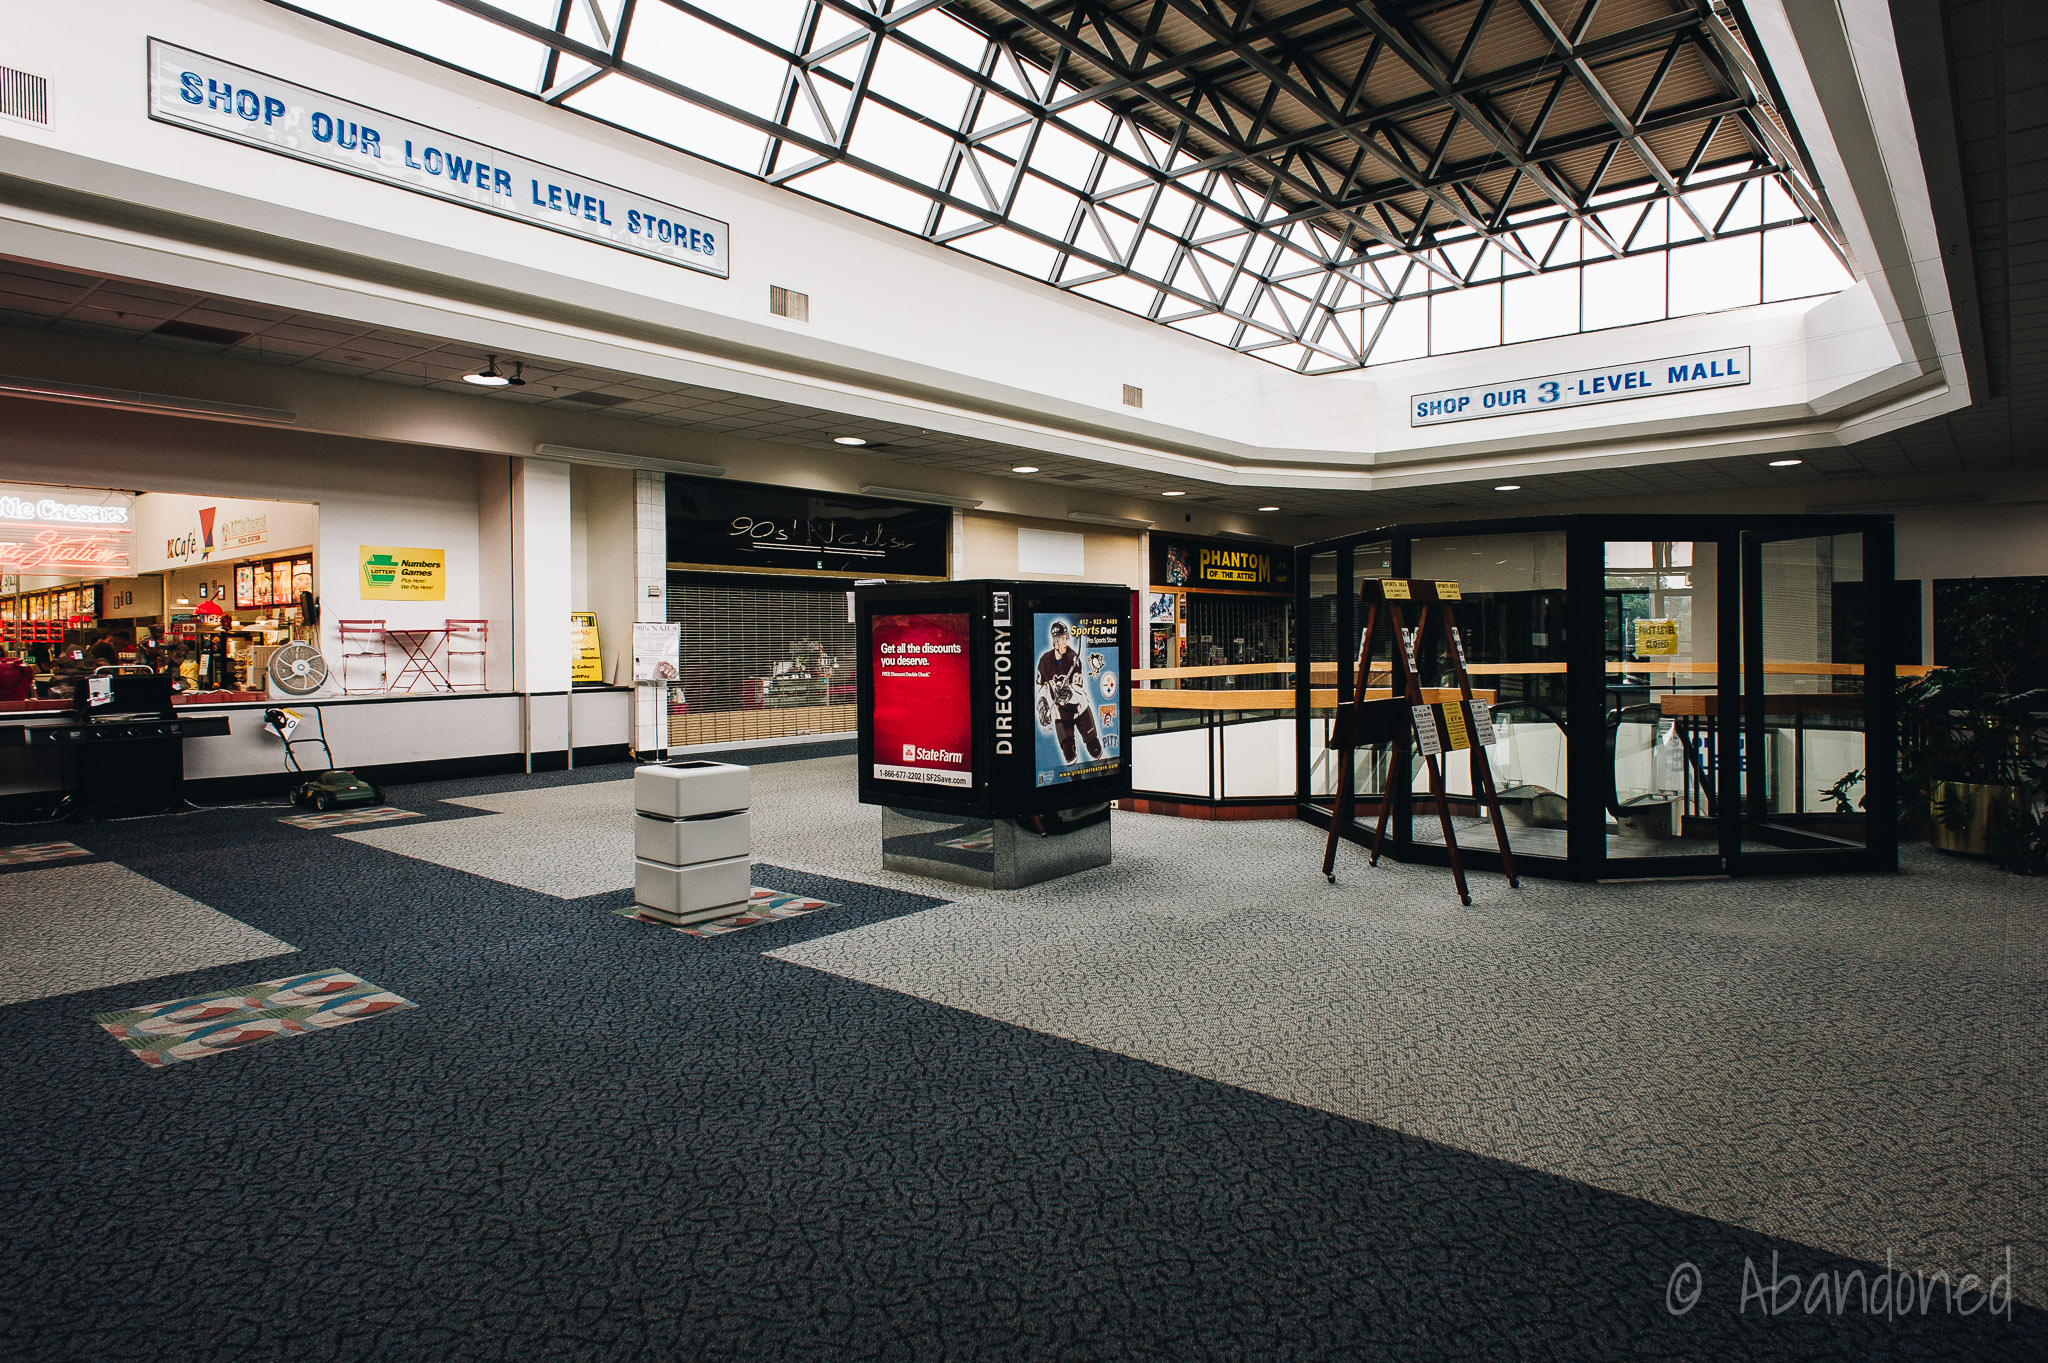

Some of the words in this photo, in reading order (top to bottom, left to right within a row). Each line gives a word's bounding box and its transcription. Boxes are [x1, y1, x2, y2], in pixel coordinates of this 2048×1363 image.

[179, 71, 286, 126] SHOP
[311, 111, 381, 158] OUR
[405, 139, 512, 197] LOWER
[531, 179, 612, 226] LEVEL
[627, 209, 716, 257] STORES
[1417, 397, 1470, 418] SHOP
[1483, 389, 1527, 409] OUR
[1668, 359, 1741, 384] MALL
[37, 499, 128, 523] Caesars
[17, 529, 130, 570] Station
[401, 560, 441, 568] Numbers
[1200, 549, 1271, 583] PHANTOM
[1221, 571, 1233, 579] THE
[1236, 572, 1254, 580] ATTIC
[1070, 626, 1100, 638] Sports
[1100, 626, 1118, 634] Deli
[1656, 626, 1676, 634] LEVEL
[880, 643, 896, 654] Get
[896, 643, 906, 654] all
[907, 643, 920, 654] the
[922, 643, 962, 654] discounts
[880, 656, 896, 668] you
[896, 655, 930, 666] deserve.
[994, 628, 1013, 755] DIRECTORY
[1102, 736, 1118, 748] PITT
[880, 769, 922, 780] 1-866-677-2202
[926, 773, 966, 785] SF2Save.com
